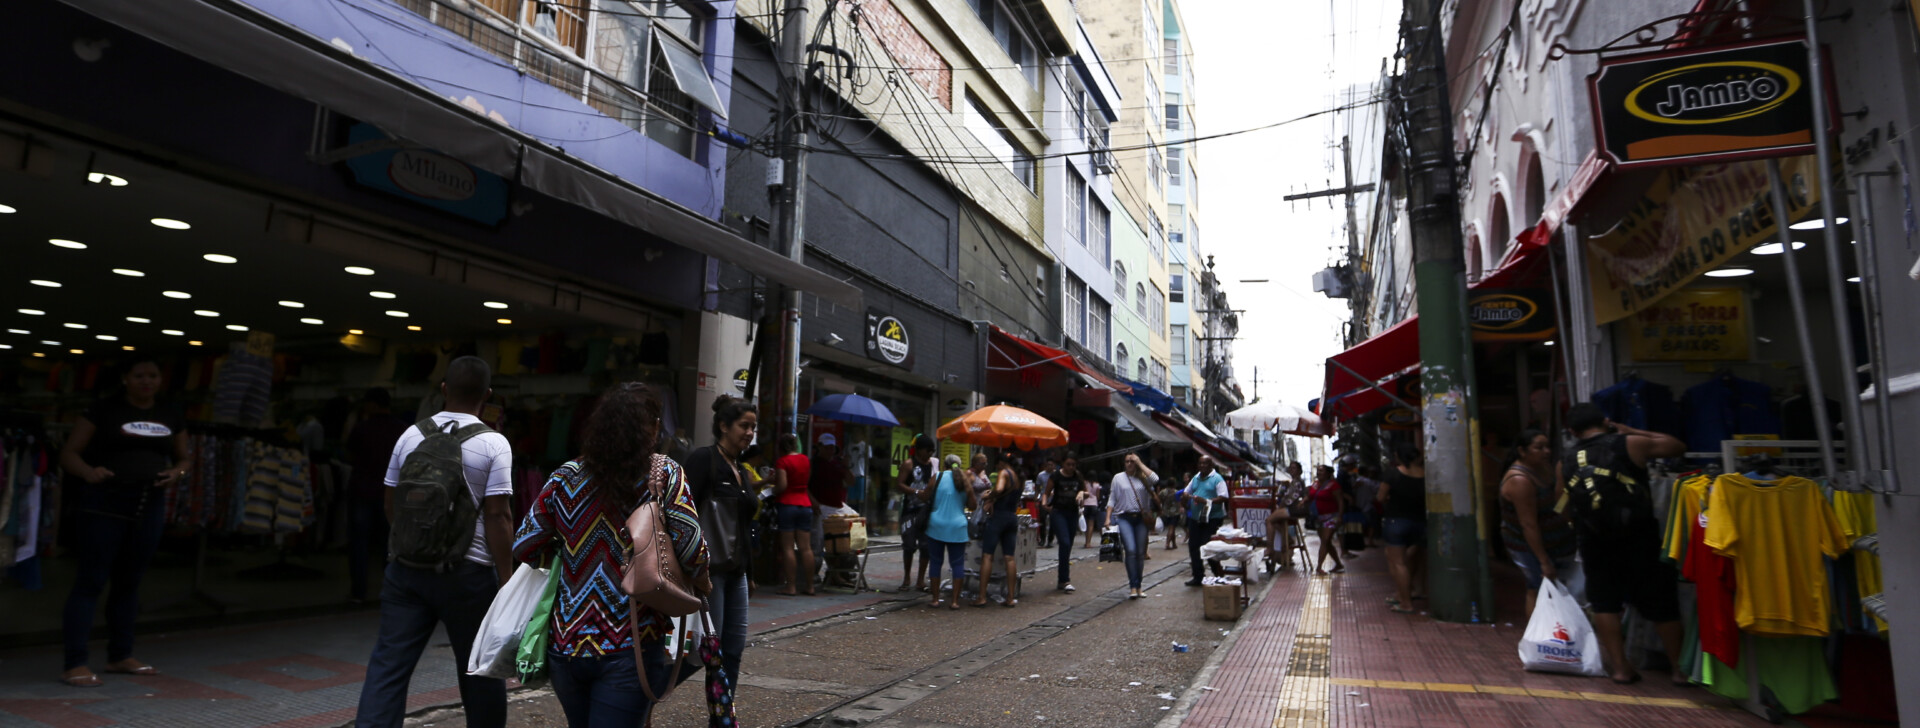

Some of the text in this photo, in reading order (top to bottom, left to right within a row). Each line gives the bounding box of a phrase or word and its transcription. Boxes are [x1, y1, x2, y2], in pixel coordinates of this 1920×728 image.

[1656, 77, 1781, 117] JAMBO
[402, 153, 473, 194] Milano
[1700, 228, 1725, 264] DO
[1470, 306, 1523, 322] JAMBO
